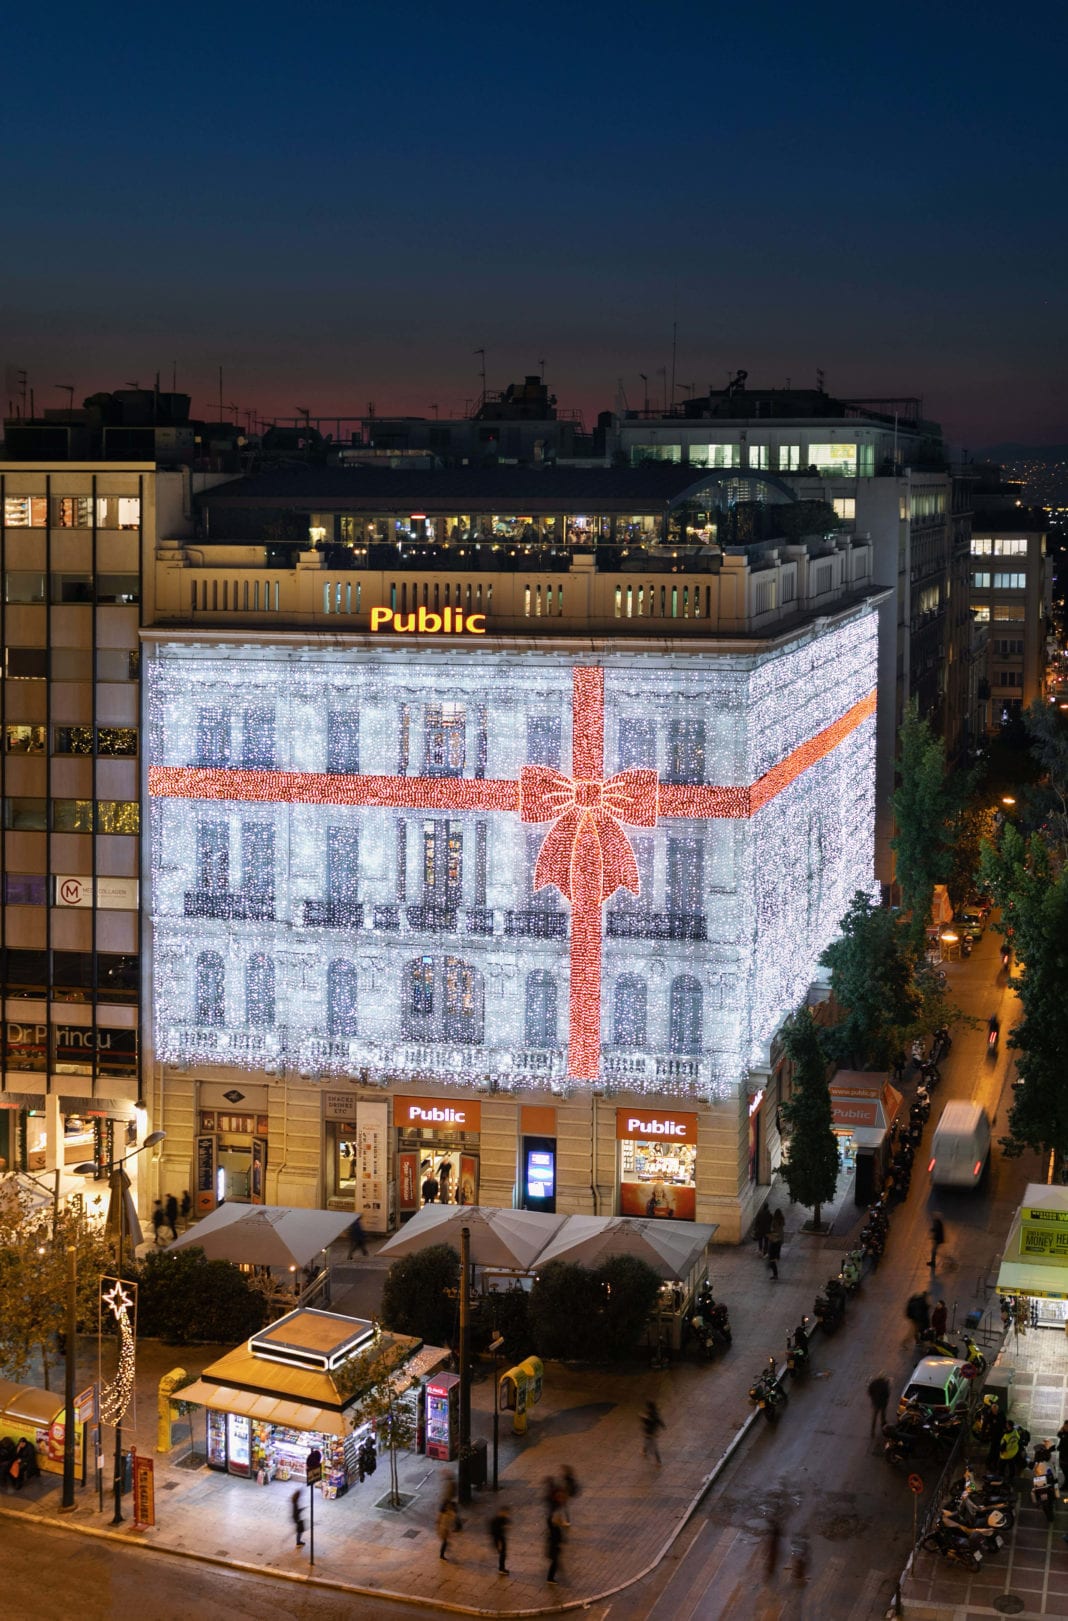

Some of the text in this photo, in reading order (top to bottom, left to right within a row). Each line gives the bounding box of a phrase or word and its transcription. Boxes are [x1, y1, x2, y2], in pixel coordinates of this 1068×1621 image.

[370, 606, 486, 634] Public
[7, 1023, 32, 1043] Dr
[409, 1106, 466, 1123] Public
[832, 1108, 873, 1120] Public
[628, 1118, 687, 1136] Public
[1026, 1235, 1054, 1247] MONEY
